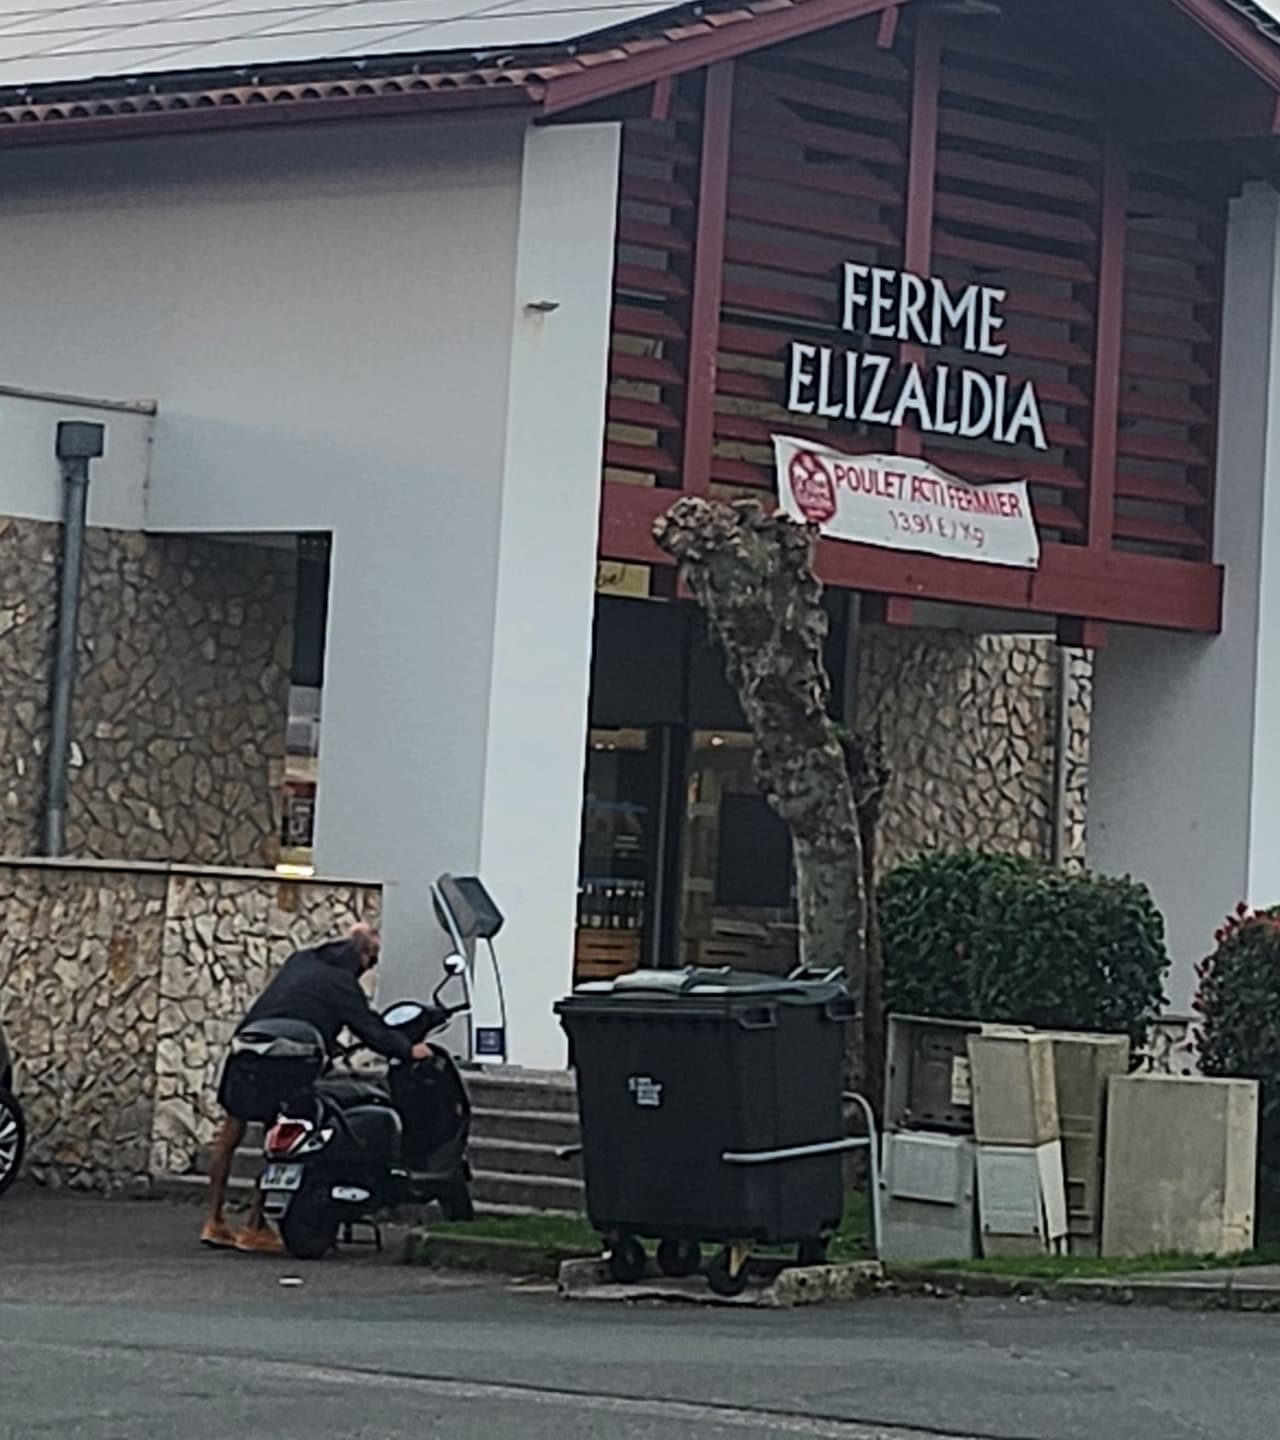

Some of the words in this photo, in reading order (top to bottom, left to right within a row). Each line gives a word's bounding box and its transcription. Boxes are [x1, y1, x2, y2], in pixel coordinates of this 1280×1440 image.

[842, 261, 1007, 357] FERME
[787, 341, 1048, 450] ELIZALDIA
[833, 463, 907, 502] POULET
[946, 482, 1023, 519] FERMIER
